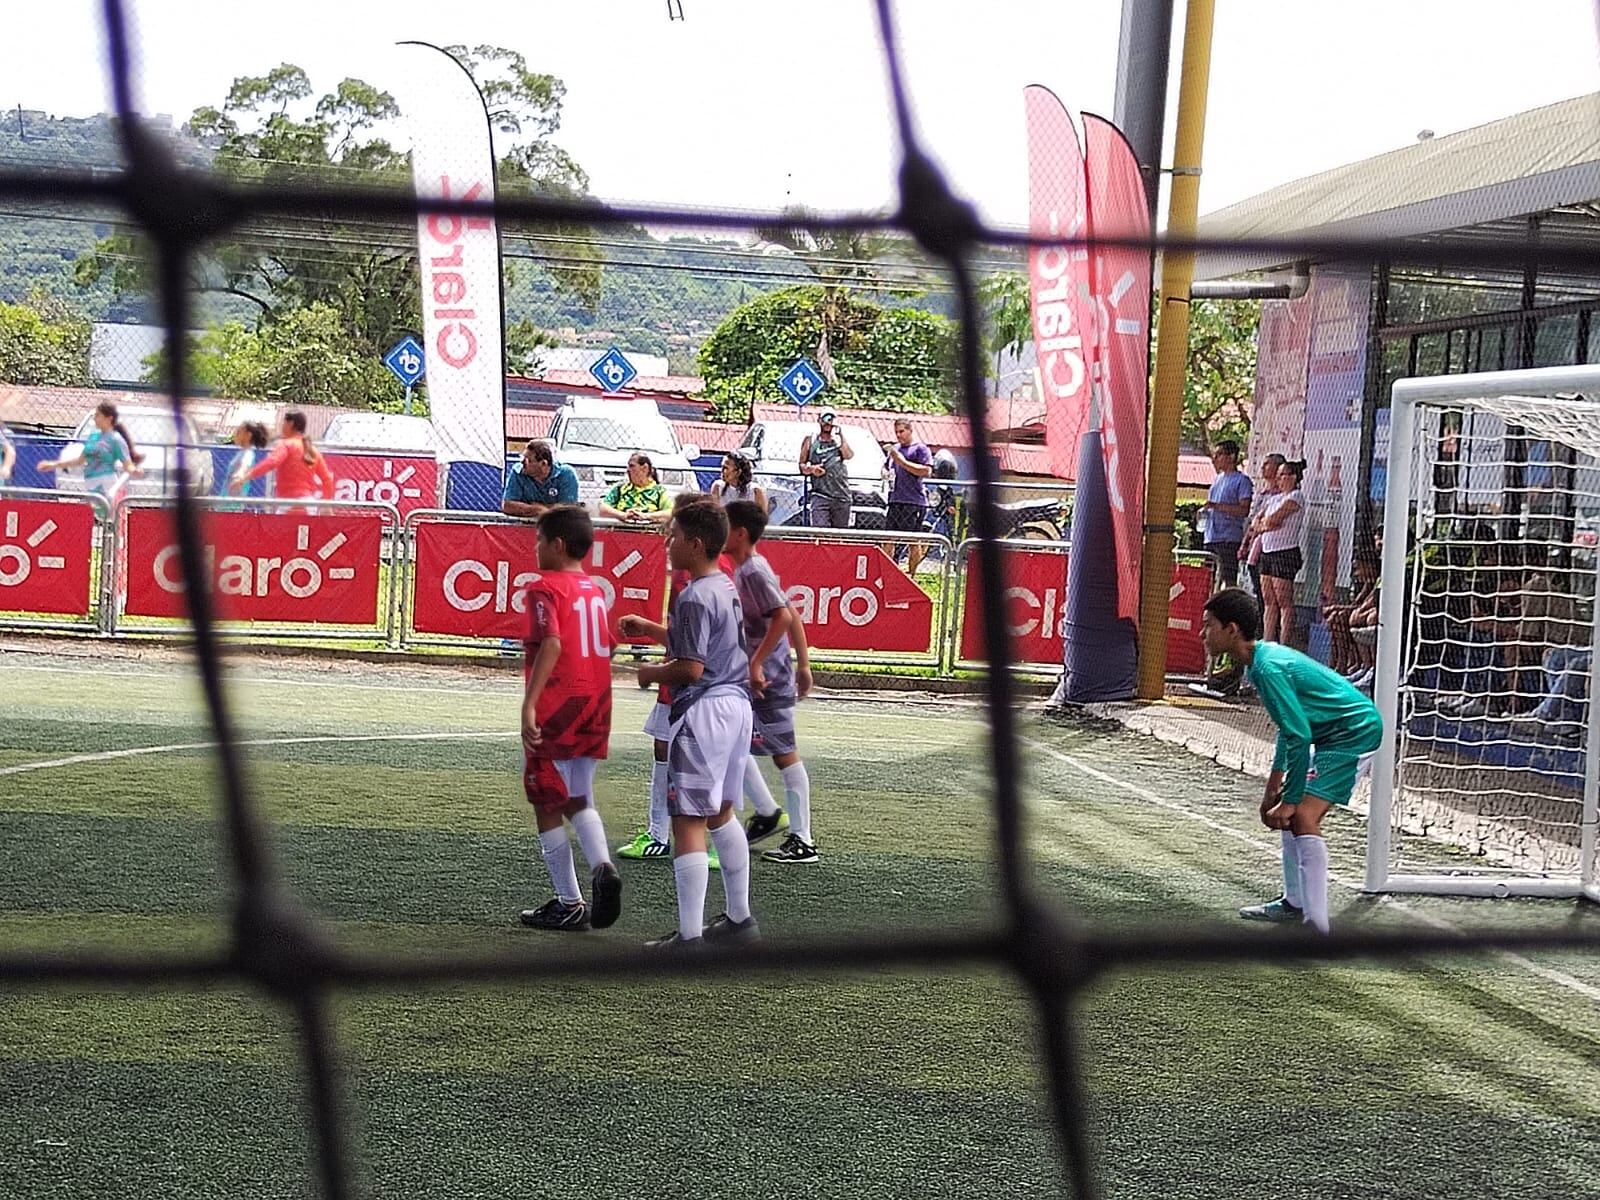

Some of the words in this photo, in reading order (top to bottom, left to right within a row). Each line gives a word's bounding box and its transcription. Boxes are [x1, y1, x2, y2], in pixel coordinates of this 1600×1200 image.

[427, 208, 478, 369] Claro
[1037, 246, 1085, 398] Claro
[572, 596, 610, 657] 10
